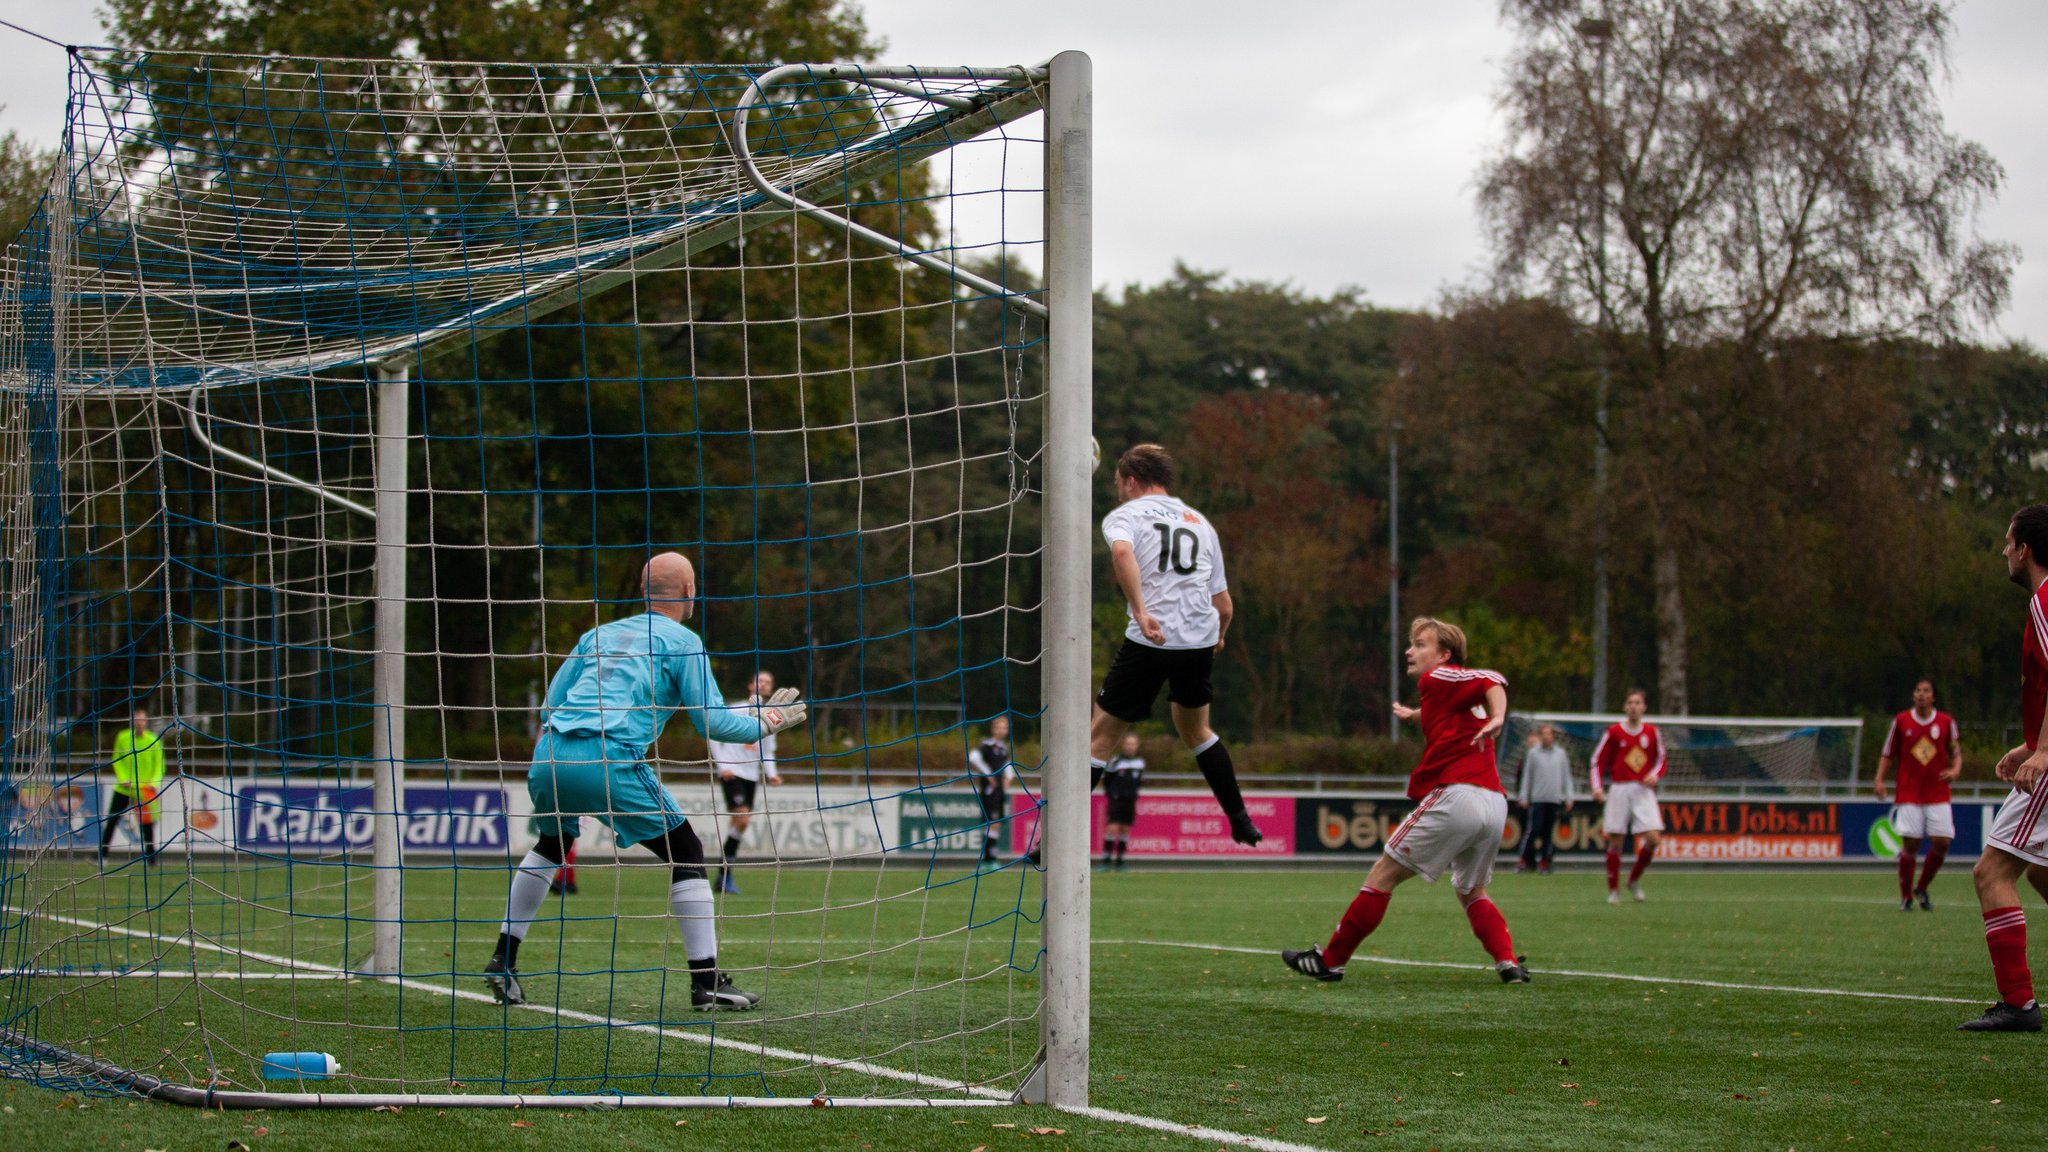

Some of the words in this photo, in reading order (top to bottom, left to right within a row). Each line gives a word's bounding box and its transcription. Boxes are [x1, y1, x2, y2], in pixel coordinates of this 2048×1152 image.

[1153, 522, 1200, 576] 10
[246, 792, 501, 845] Raboank
[910, 827, 984, 850] LEIDE
[1738, 803, 1838, 834] Jobs.nl
